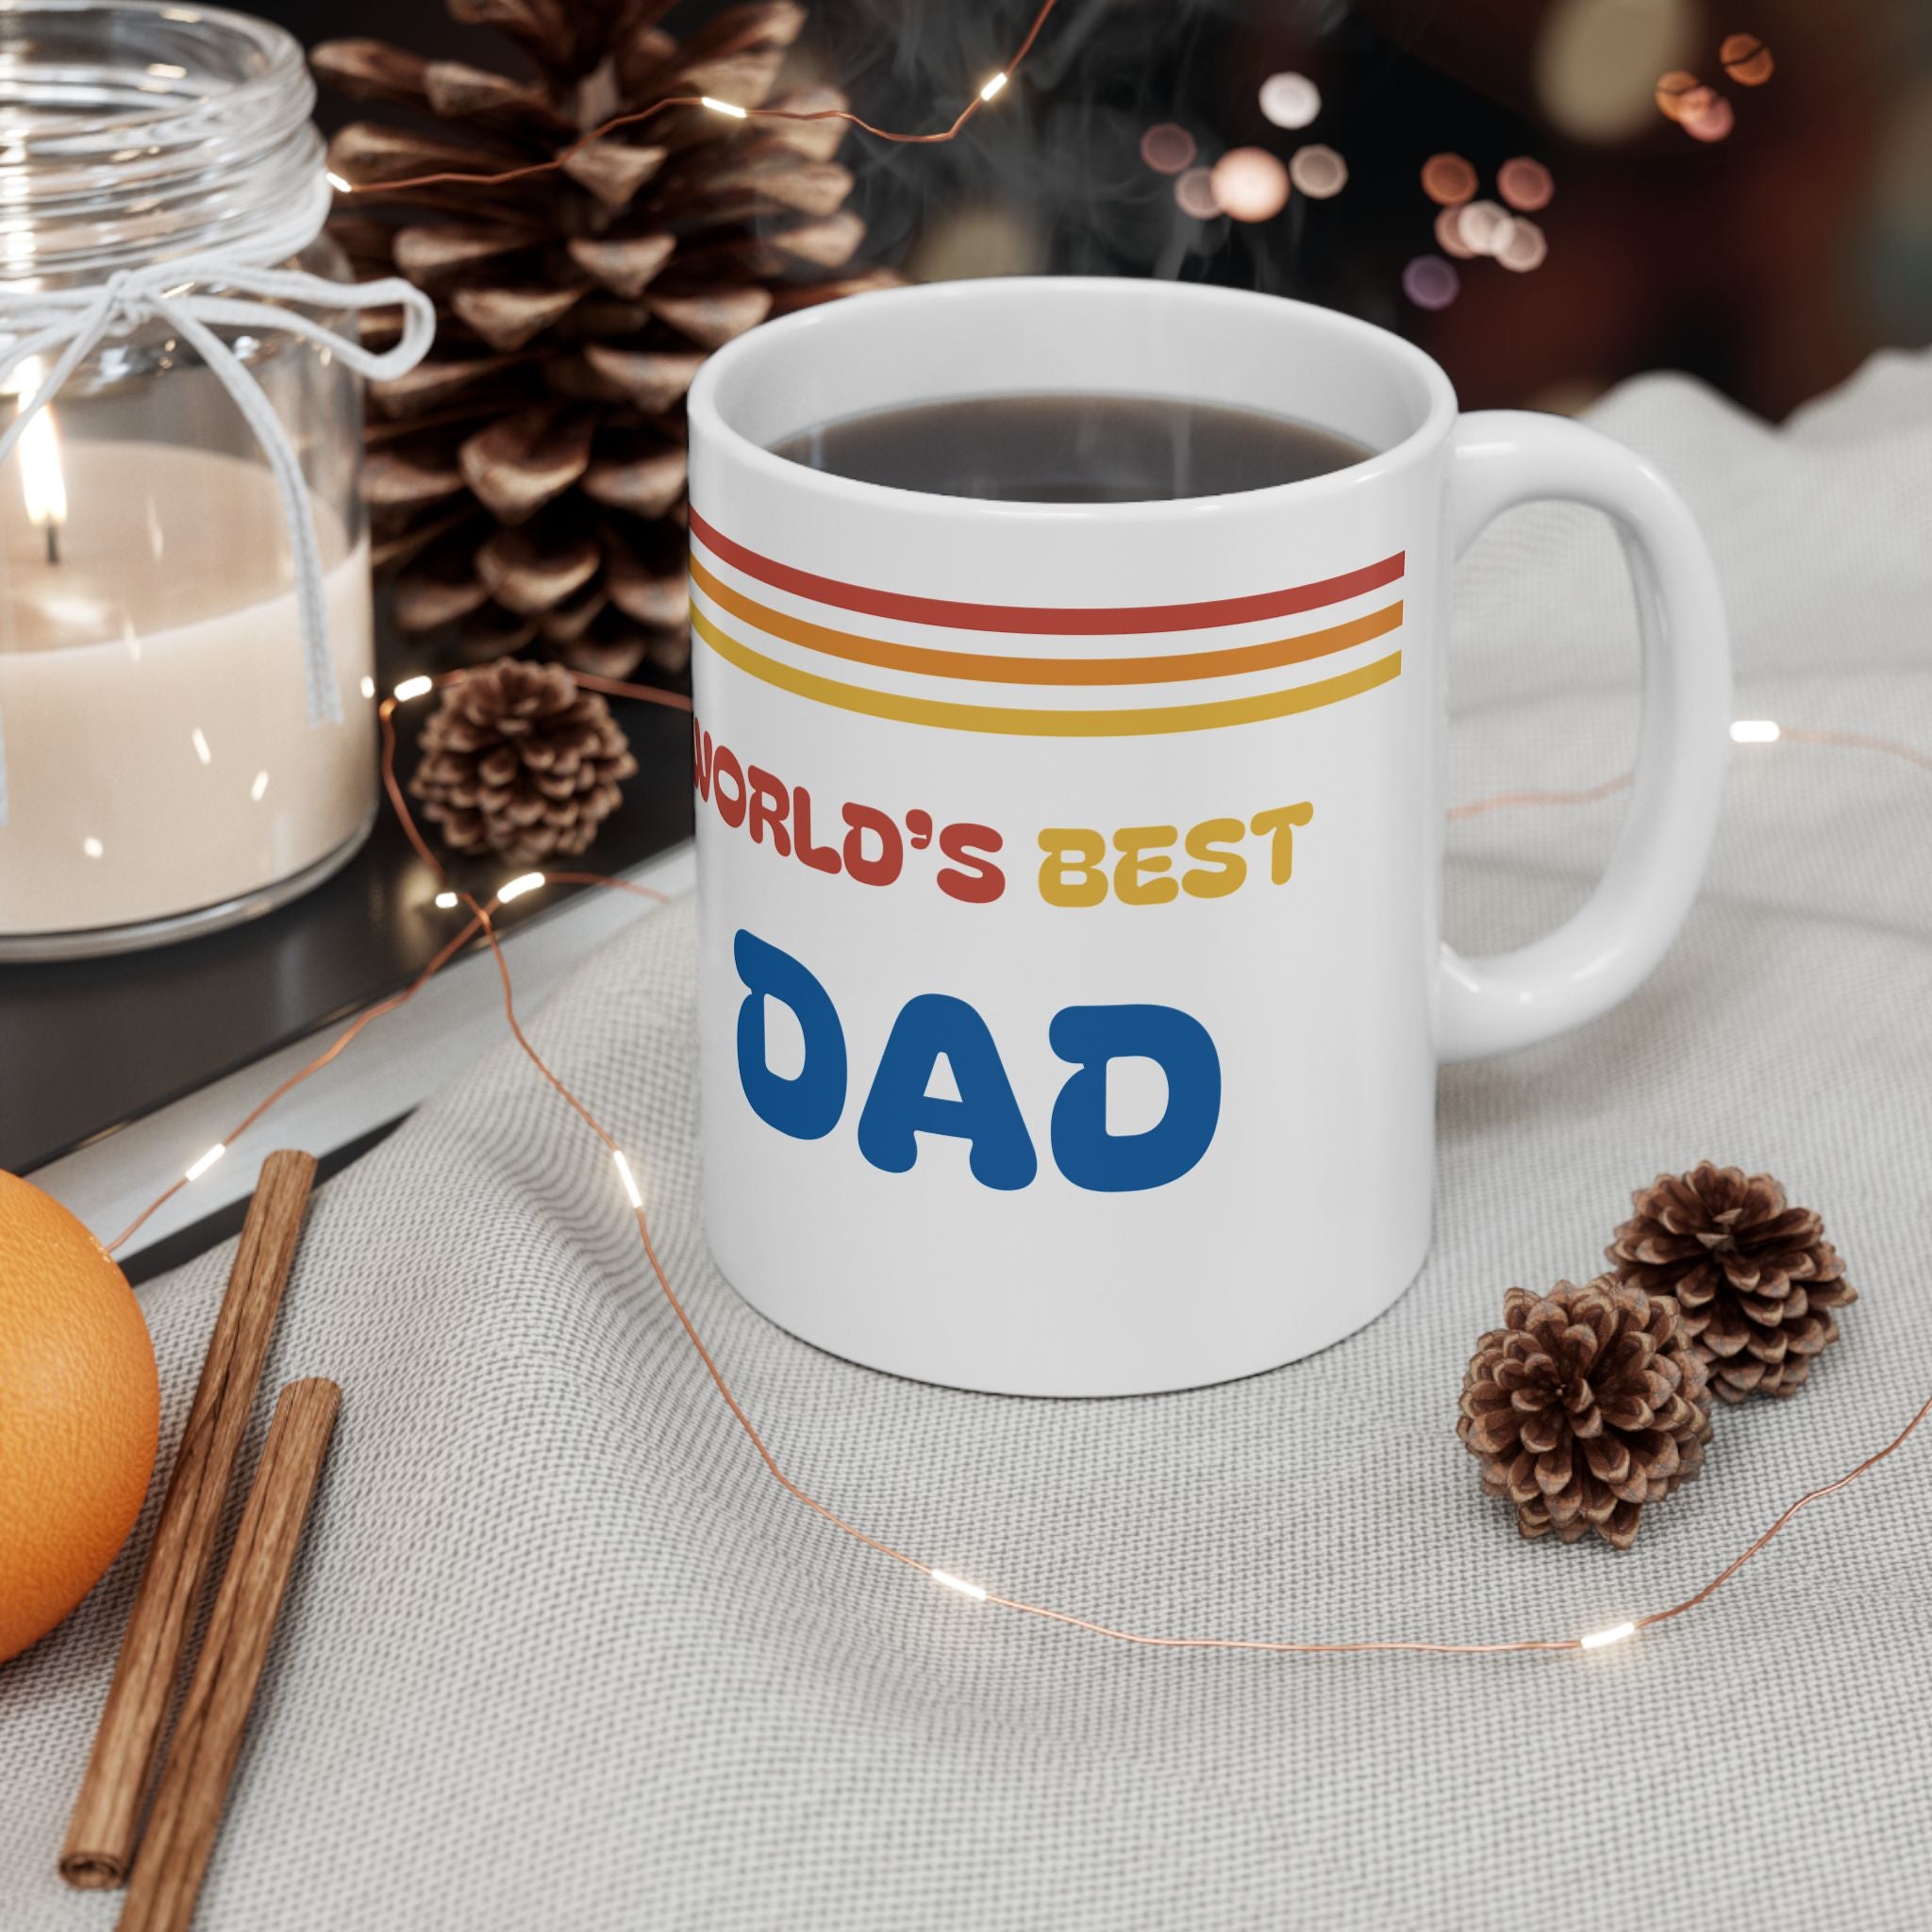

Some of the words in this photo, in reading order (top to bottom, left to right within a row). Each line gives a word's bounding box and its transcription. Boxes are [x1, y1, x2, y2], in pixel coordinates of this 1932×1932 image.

[693, 717, 1006, 904] WORLD'S
[1038, 802, 1314, 908] BEST
[734, 929, 1222, 1192] DAD
